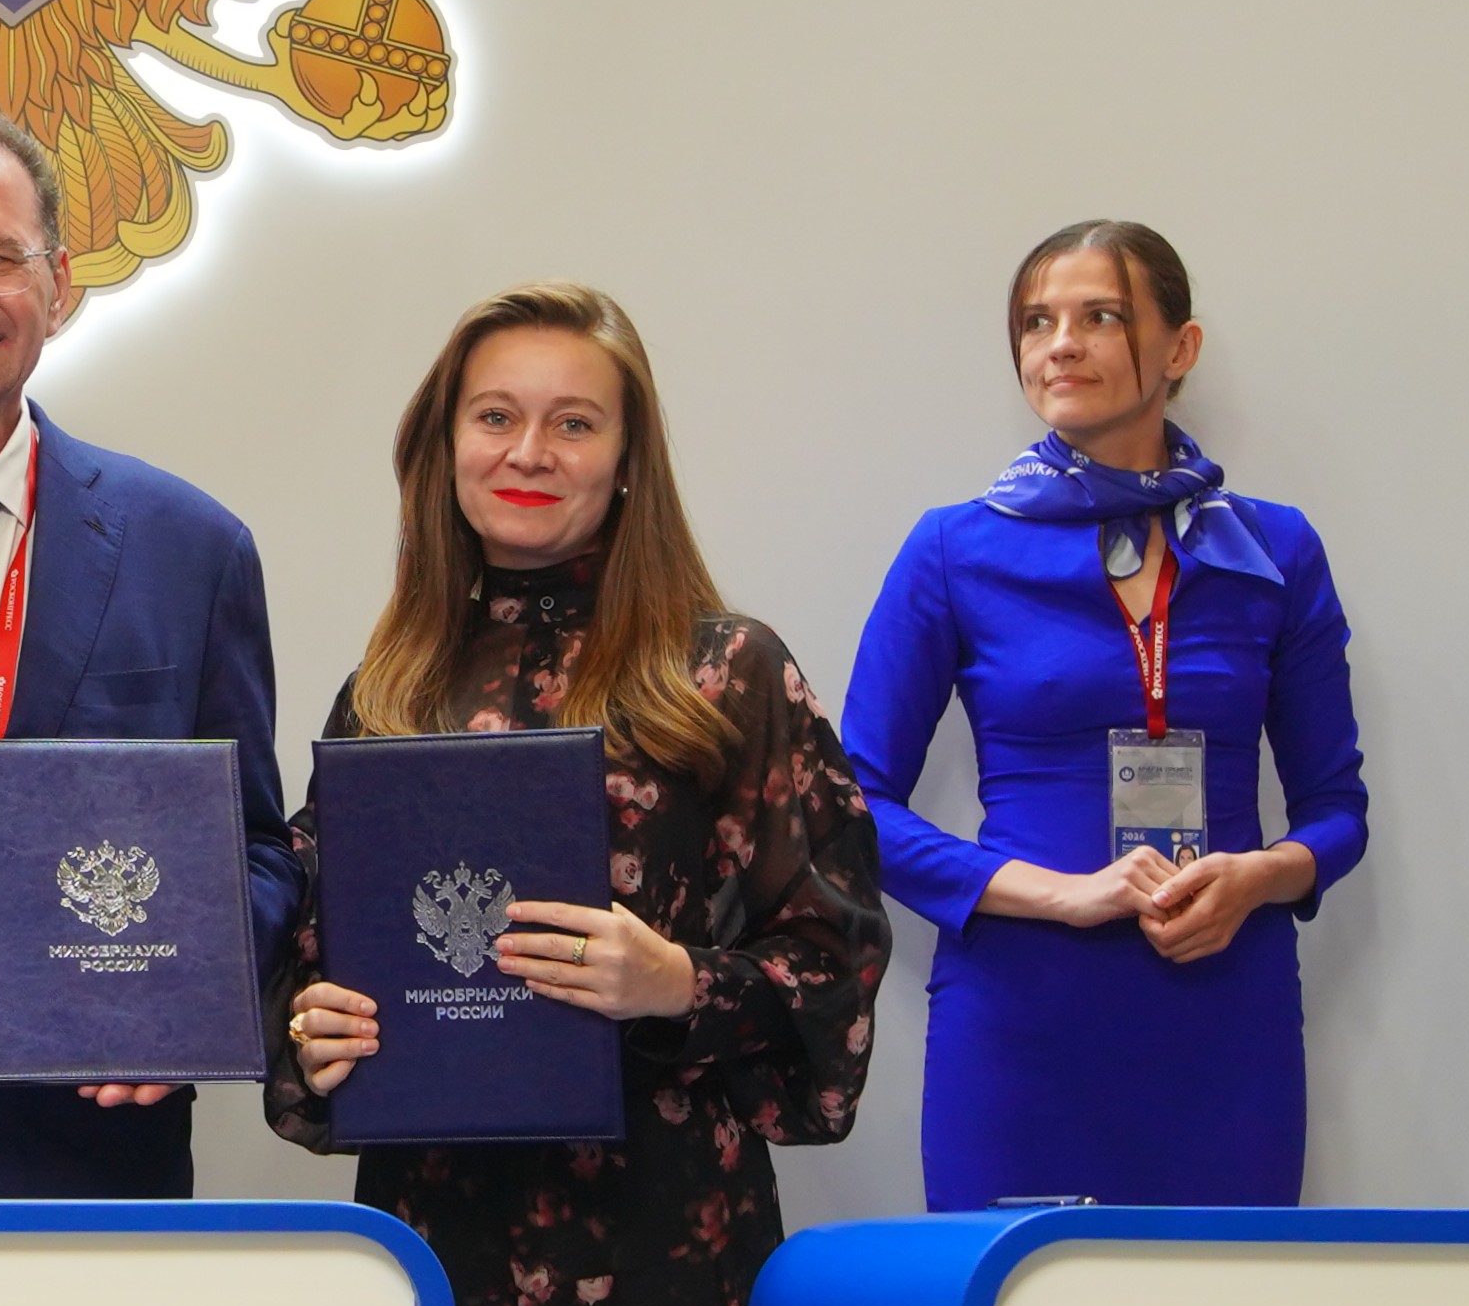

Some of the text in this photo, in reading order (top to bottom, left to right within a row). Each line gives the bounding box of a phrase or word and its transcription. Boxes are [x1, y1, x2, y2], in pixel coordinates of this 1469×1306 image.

[48, 944, 178, 958] МИНОБРНАУКИ
[80, 959, 149, 973] РОССИИ
[405, 986, 534, 1004] МИНОБРНАУКИ
[435, 1005, 505, 1021] РОССИИ
